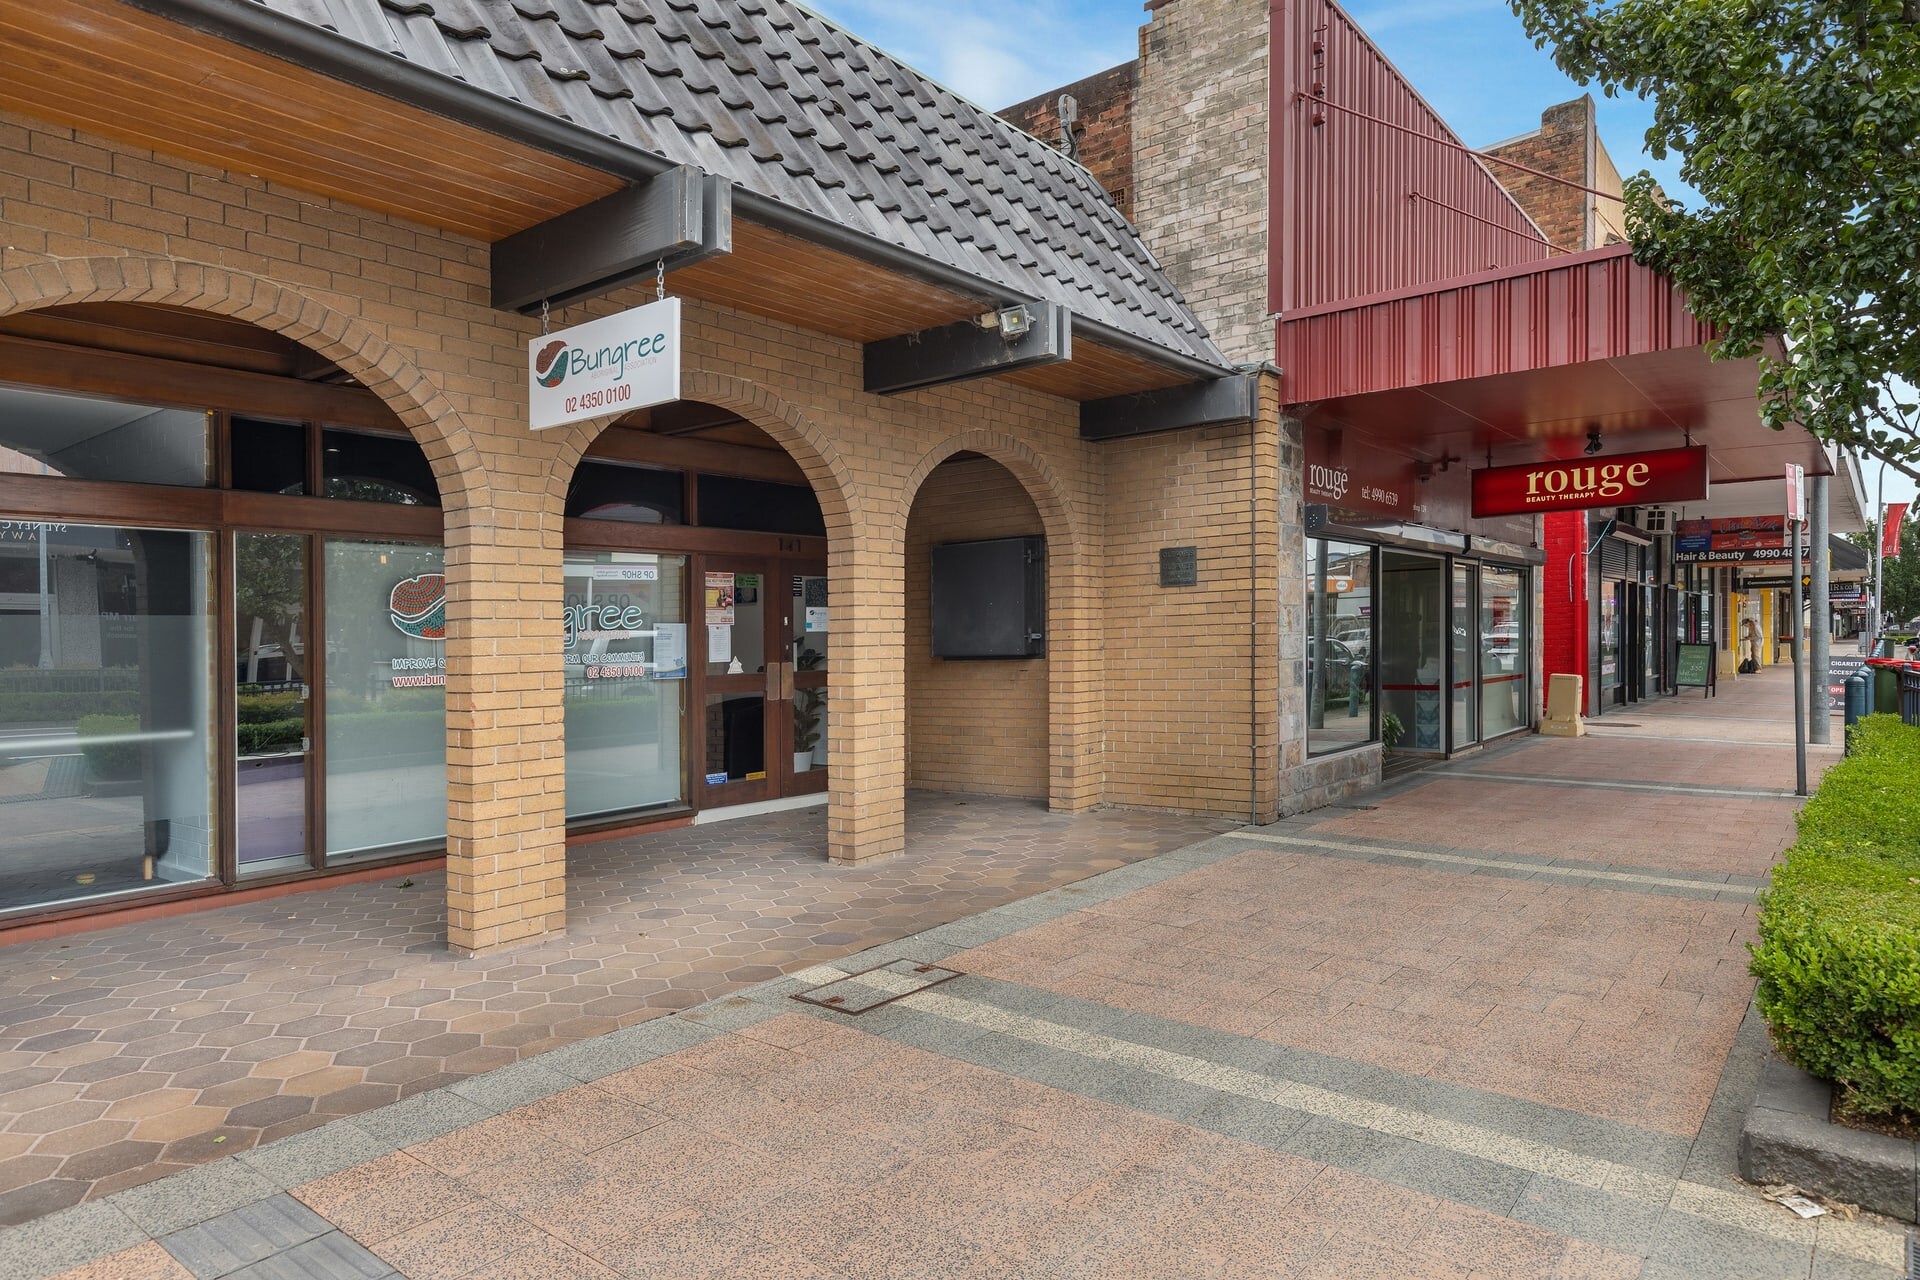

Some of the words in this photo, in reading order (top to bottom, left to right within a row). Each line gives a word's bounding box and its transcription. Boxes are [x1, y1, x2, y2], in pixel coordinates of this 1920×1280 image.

[571, 333, 666, 381] Bungree
[565, 398, 577, 414] 02
[579, 391, 604, 410] 4350
[606, 384, 631, 405] 0100
[1309, 464, 1348, 500] rouge
[1526, 462, 1650, 497] rouge
[1361, 486, 1371, 500] tel:
[1371, 488, 1385, 503] 4990
[1526, 495, 1556, 503] BEAUTY
[1559, 491, 1595, 500] THERAPY
[1676, 552, 1697, 561] Hair
[1698, 552, 1707, 560] &
[1708, 551, 1745, 561] Beauty
[1753, 549, 1780, 558] 4990
[1782, 547, 1810, 557] 487
[563, 604, 643, 650] gree
[392, 658, 435, 670] IMPROVE
[582, 653, 600, 664] OUR
[600, 651, 645, 664] COMMUNITY
[392, 673, 446, 687] www.bun
[587, 667, 599, 678] 02
[600, 666, 622, 677] 4350
[622, 665, 644, 677] 0100
